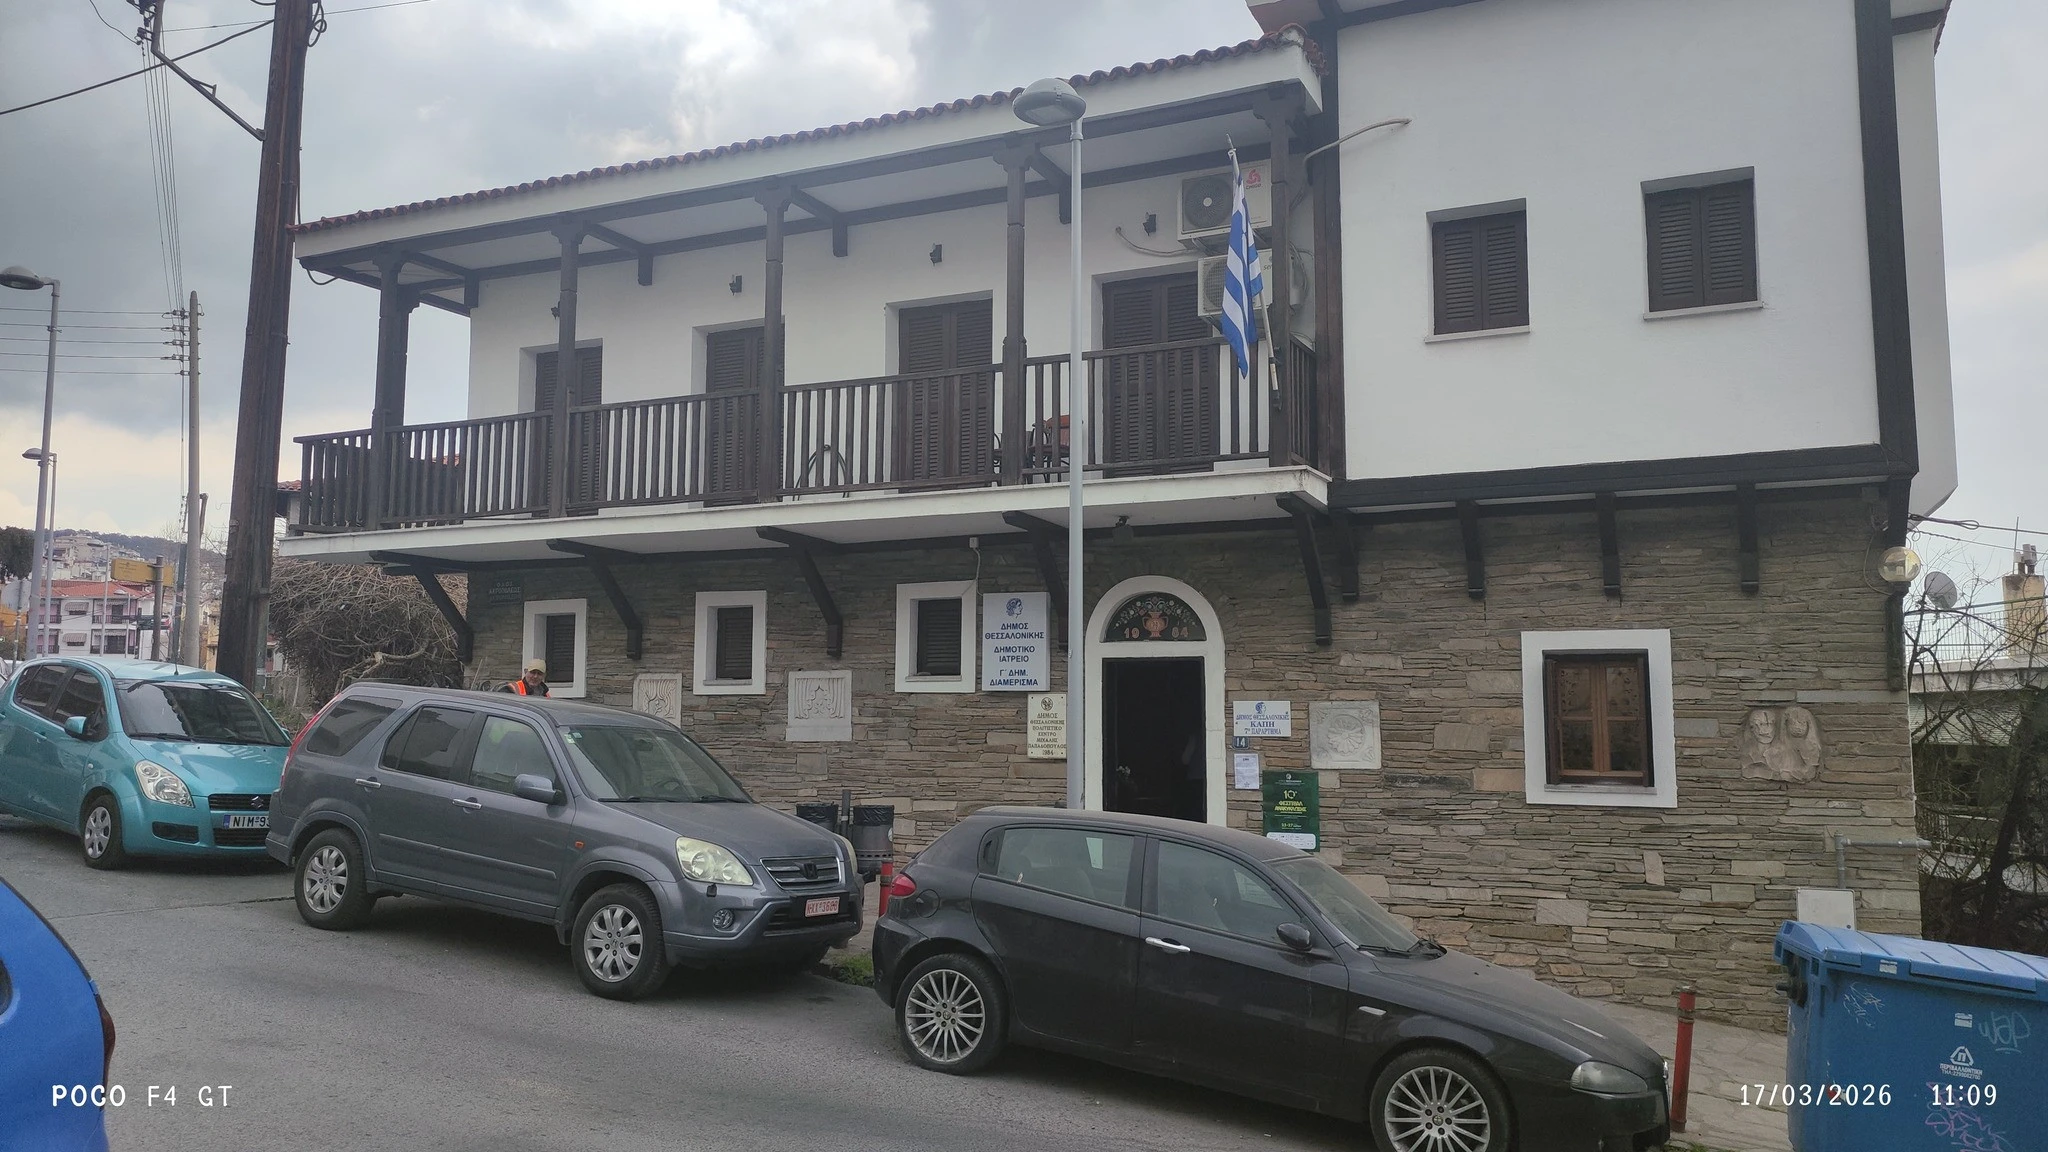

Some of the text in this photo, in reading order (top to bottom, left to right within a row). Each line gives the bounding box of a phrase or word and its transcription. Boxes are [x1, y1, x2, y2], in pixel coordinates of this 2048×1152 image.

[1000, 622, 1029, 630] ΔΗΜΟΣ
[985, 631, 1045, 640] ΘΕΣΣΑΛΟΝΙΚΗΣ
[993, 645, 1035, 653] ΔΗΜΟΤΙΚΟ
[999, 655, 1029, 663] ΙΑΤΡΕΙΟ
[989, 678, 1038, 686] ΔΙΑΜΕΡΙΣΜΑ
[1236, 737, 1246, 747] 14
